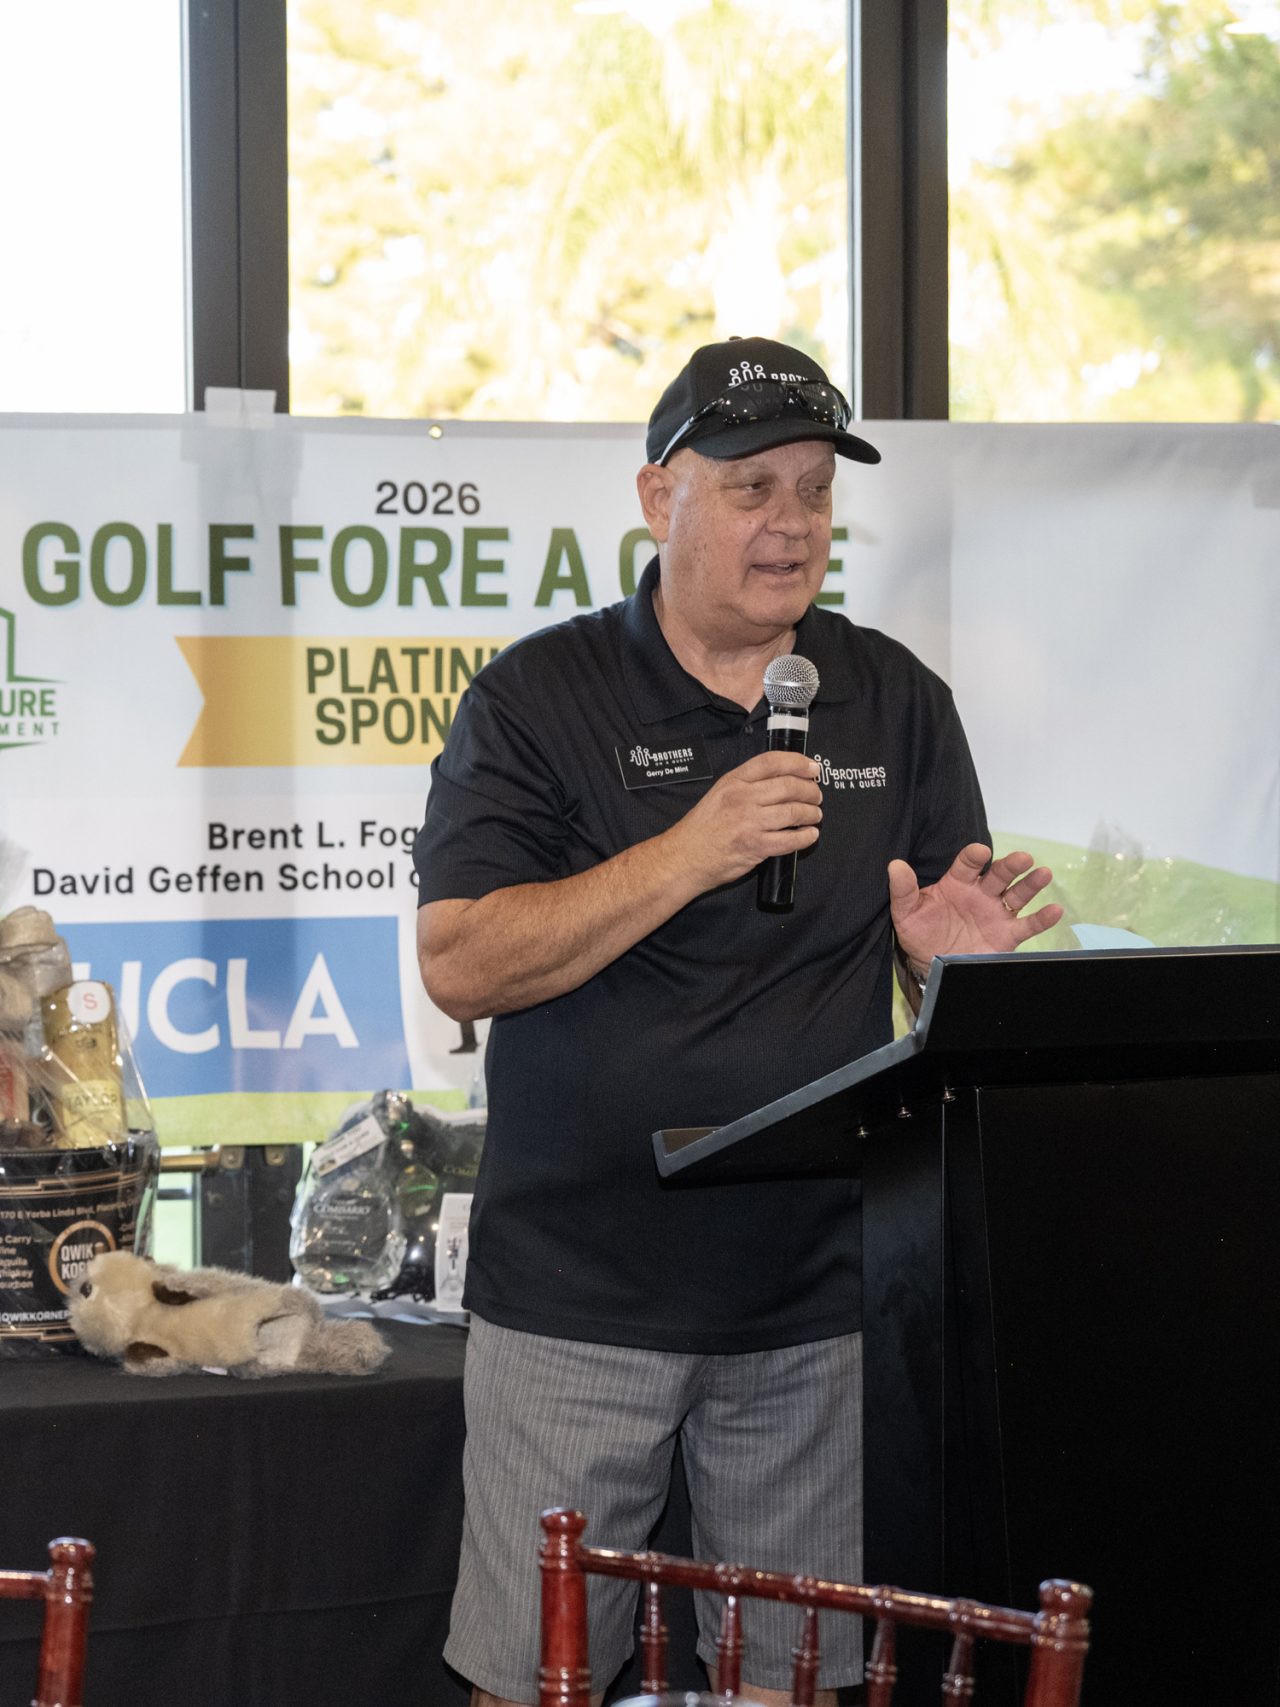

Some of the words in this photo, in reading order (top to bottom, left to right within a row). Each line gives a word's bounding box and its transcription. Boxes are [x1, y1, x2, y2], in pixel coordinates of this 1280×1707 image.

[375, 481, 481, 515] 2026
[22, 521, 255, 607] GOLF
[279, 525, 509, 607] FORE
[534, 528, 592, 607] A
[619, 528, 848, 606] CE
[307, 647, 499, 694] PLATIN
[315, 697, 451, 745] SPON
[653, 748, 693, 762] BROTHERS
[646, 769, 663, 777] Gerry
[832, 766, 886, 781] BROTHERS
[834, 780, 846, 790] ON
[850, 780, 855, 789] A
[859, 779, 886, 789] QUEST
[208, 821, 303, 851] Brent
[317, 821, 345, 848] L.
[361, 821, 418, 854] Fog
[33, 865, 135, 896] David
[149, 864, 264, 894] Geffen
[278, 861, 395, 891] School
[72, 952, 360, 1055] UCLA
[83, 993, 98, 1010] S
[4, 1234, 31, 1245] Carry
[61, 1243, 94, 1262] QWIK
